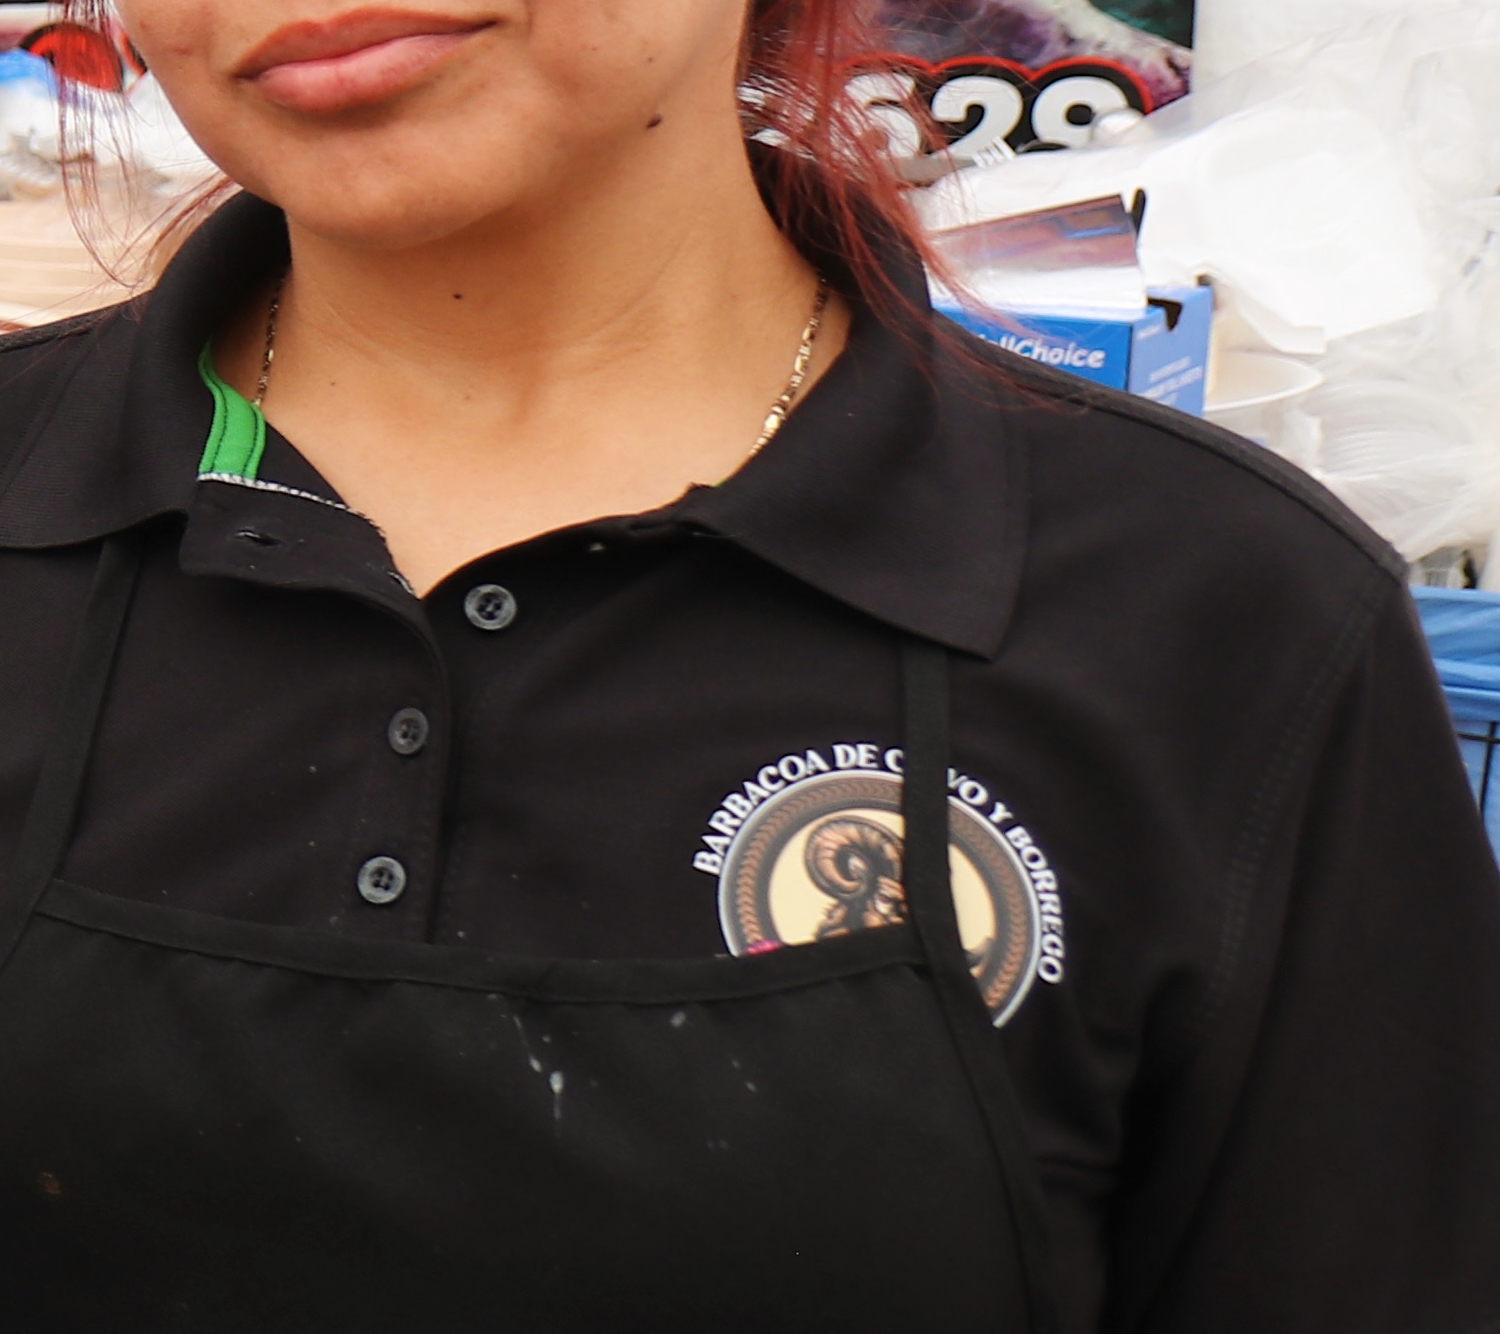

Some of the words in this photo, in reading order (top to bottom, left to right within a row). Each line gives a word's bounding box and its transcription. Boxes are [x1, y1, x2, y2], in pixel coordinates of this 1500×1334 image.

[692, 748, 830, 877] BARBACOA
[831, 742, 879, 770] DE
[989, 801, 1013, 825] Y
[1006, 824, 1065, 986] BORREGO
